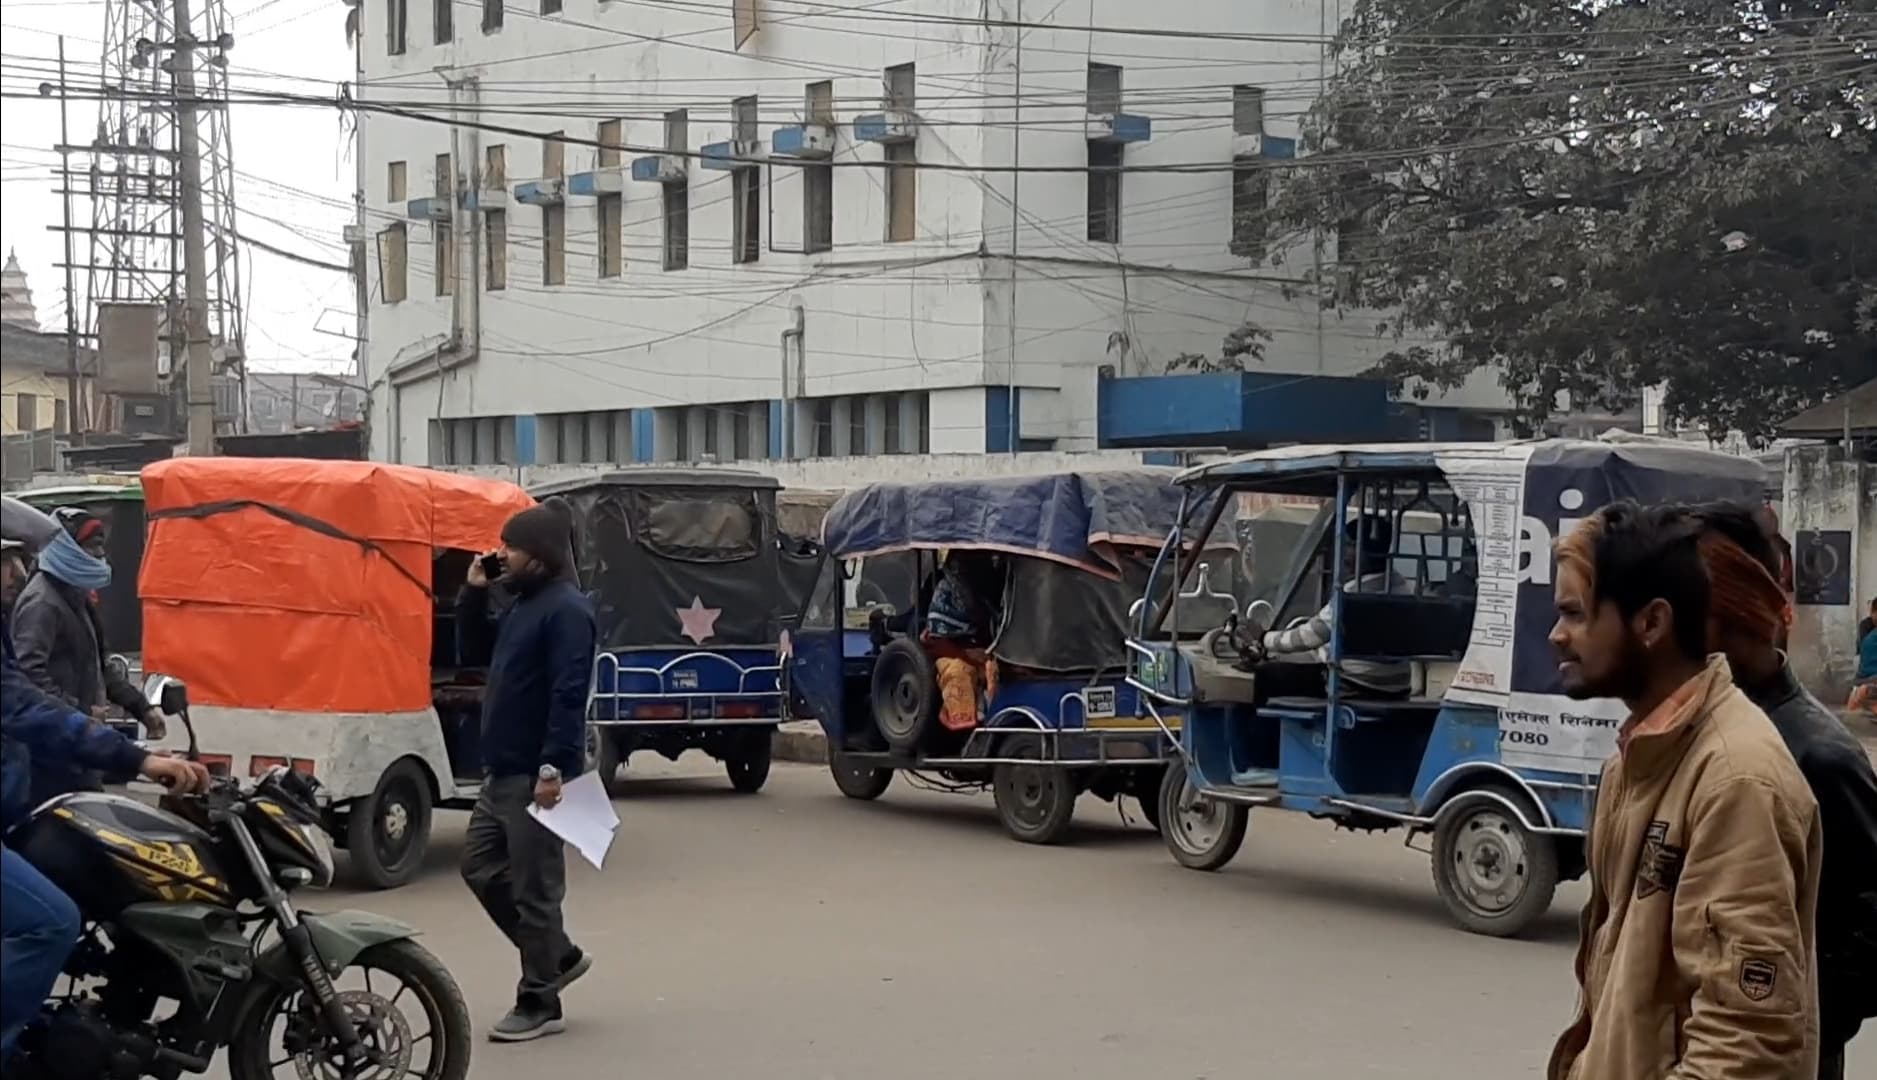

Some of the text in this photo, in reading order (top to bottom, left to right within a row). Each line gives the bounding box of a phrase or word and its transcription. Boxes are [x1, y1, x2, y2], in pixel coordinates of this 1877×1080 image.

[1560, 711, 1619, 728] सिनेमा
[1499, 729, 1549, 746] 7080
[303, 954, 334, 1004] YAMAHA
